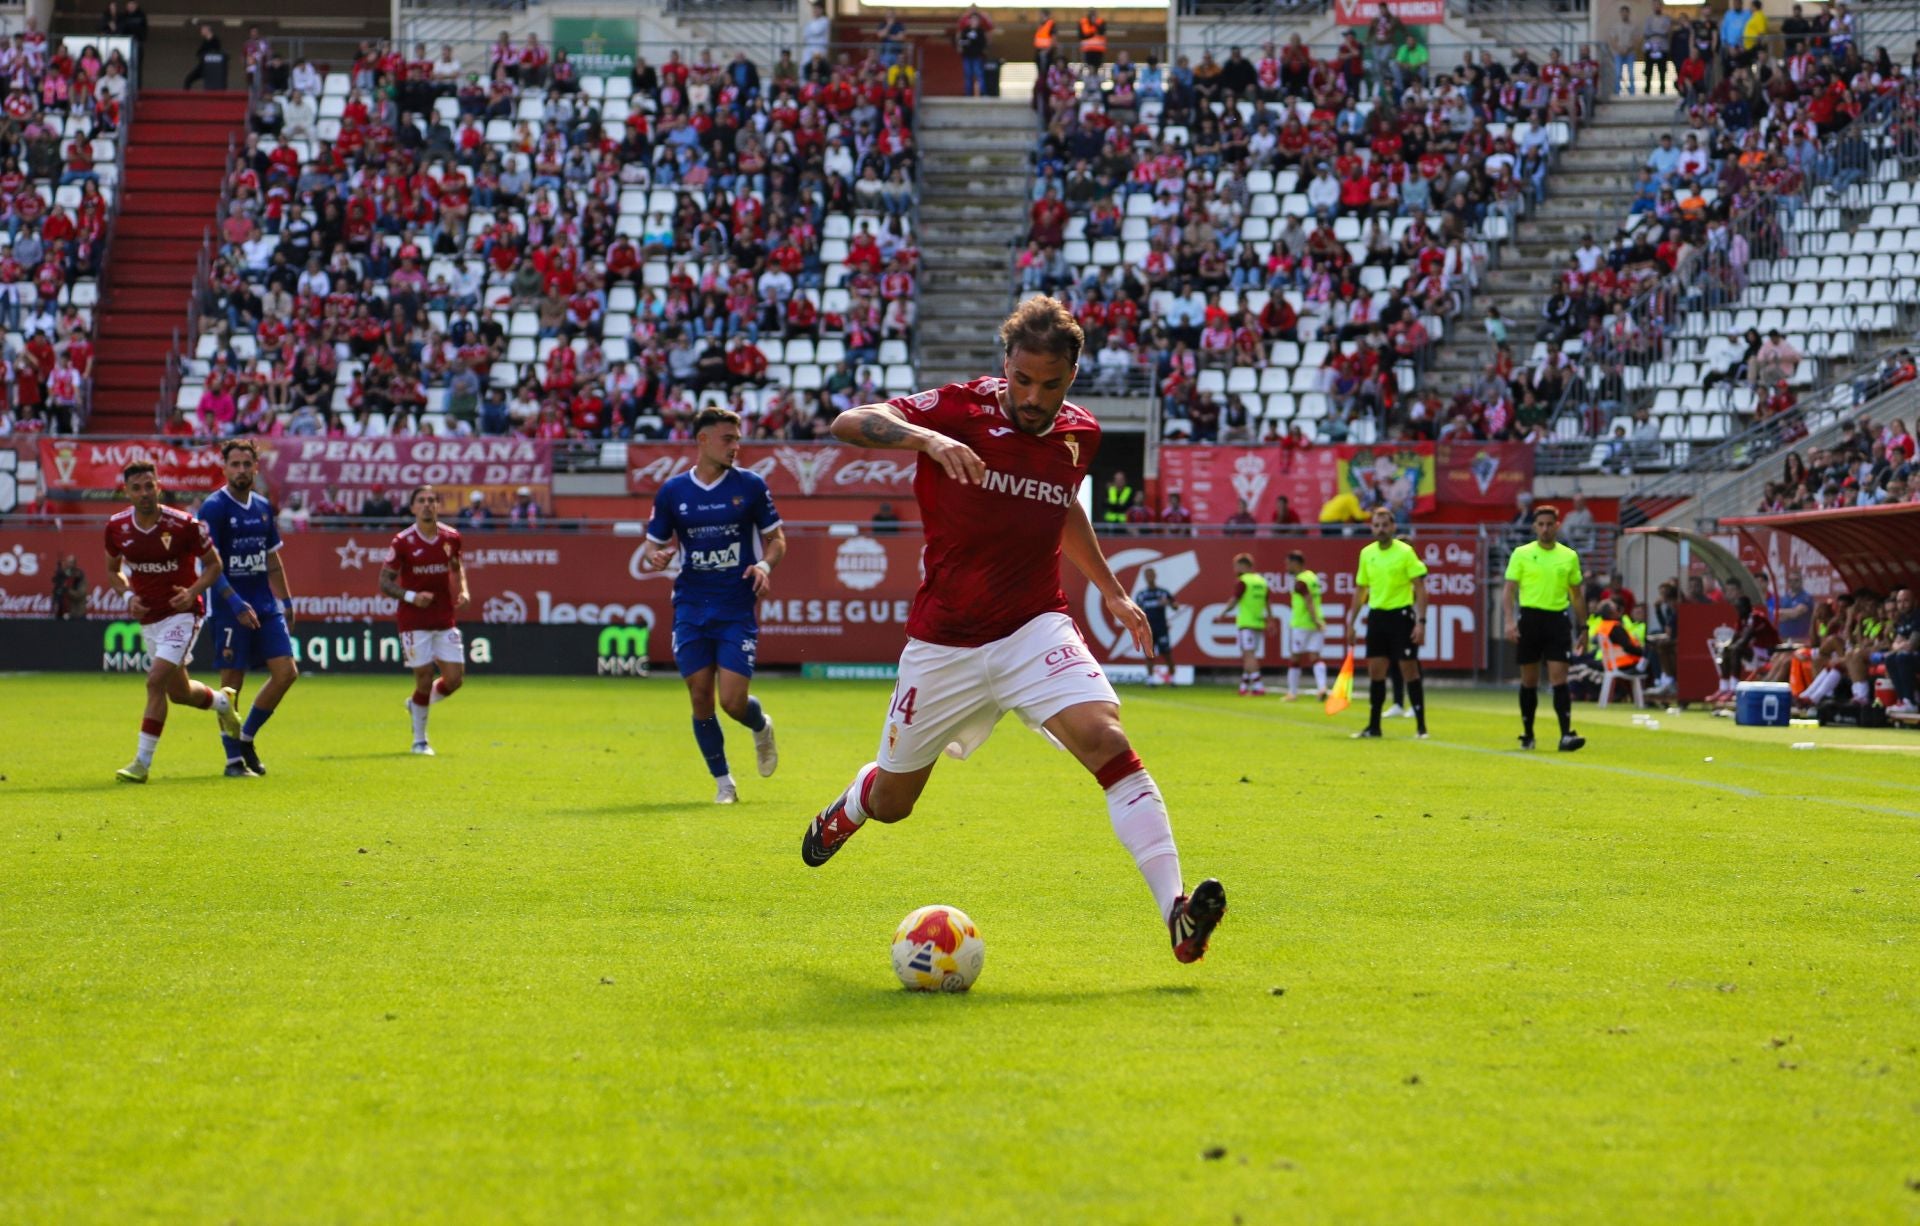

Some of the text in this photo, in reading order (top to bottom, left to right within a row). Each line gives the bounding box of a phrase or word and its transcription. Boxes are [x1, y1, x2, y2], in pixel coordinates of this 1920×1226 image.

[566, 53, 633, 68] STRELLA
[285, 463, 549, 484] EL RINCON DEL
[632, 455, 917, 485] ALA GRA
[982, 469, 1077, 508] INVERSU
[476, 550, 558, 564] LEVANTE
[292, 592, 399, 616] rramiento
[760, 600, 909, 622] MESEGUE
[223, 627, 233, 648] 7
[598, 655, 649, 677] MMC
